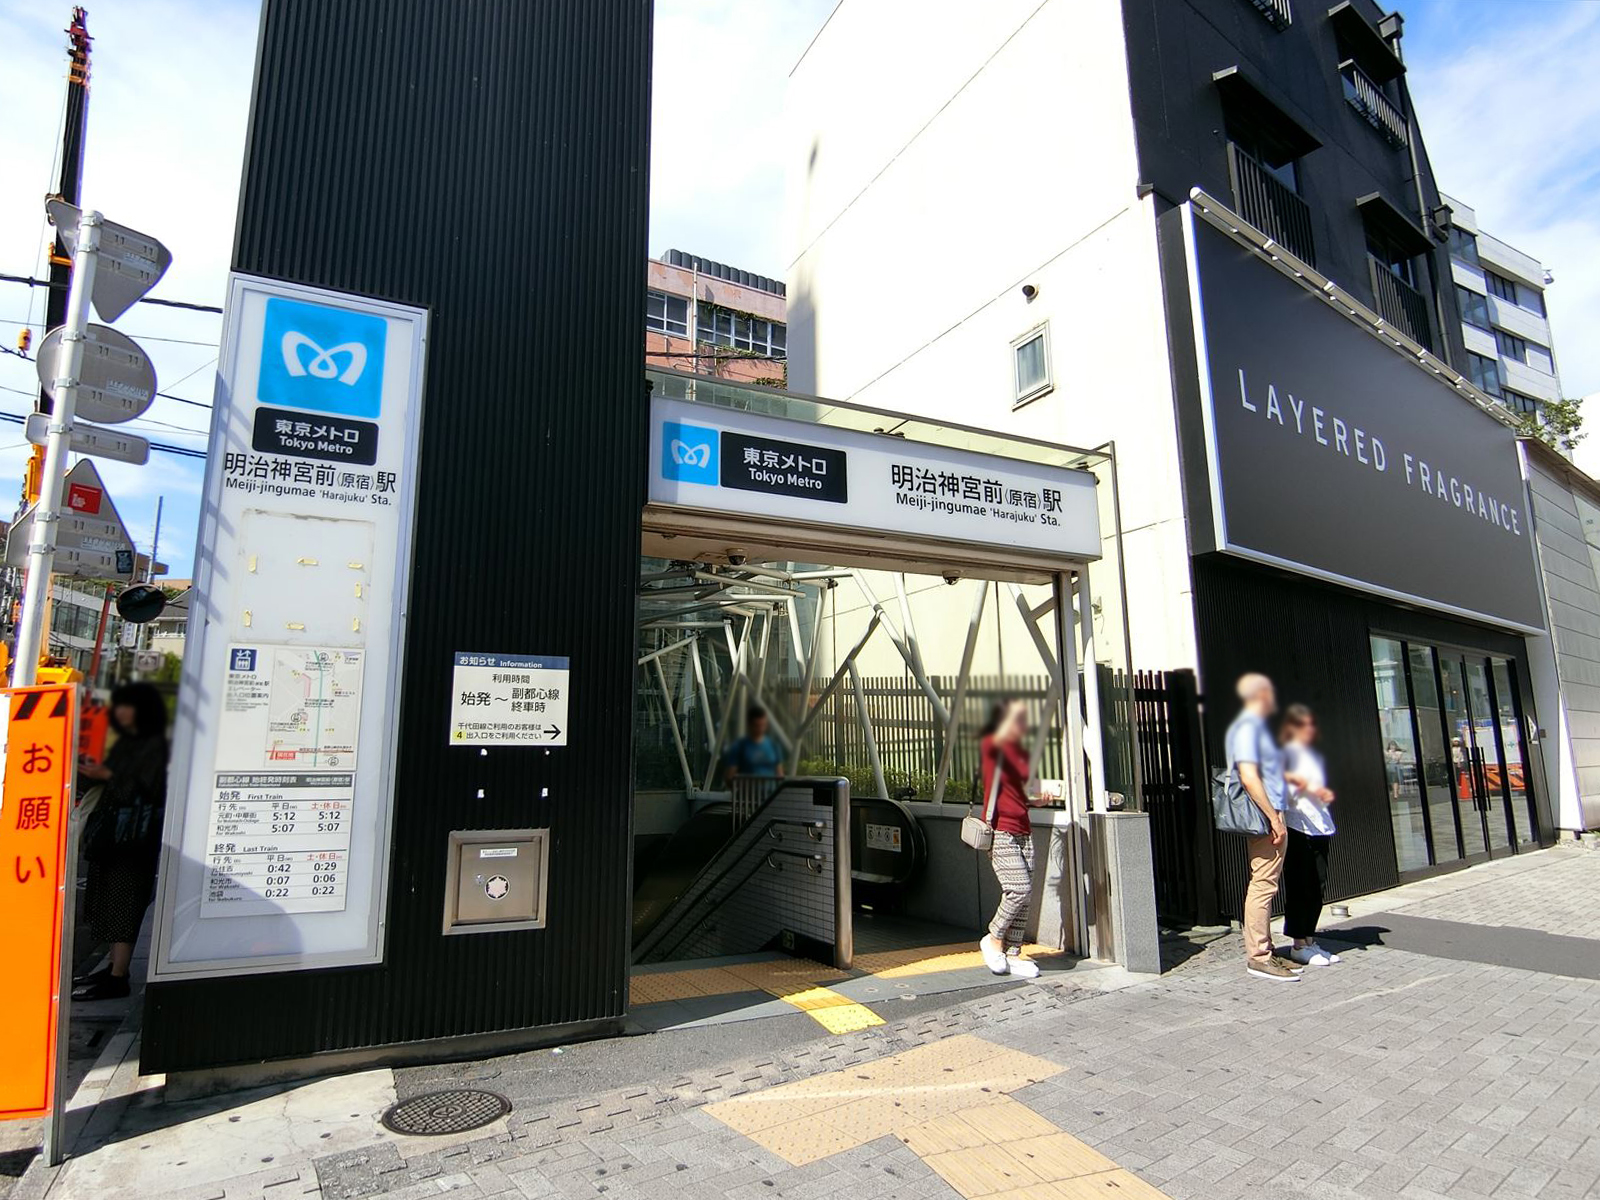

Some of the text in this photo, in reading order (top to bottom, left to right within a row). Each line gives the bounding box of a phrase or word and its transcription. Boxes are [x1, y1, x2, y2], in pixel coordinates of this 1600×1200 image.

[275, 420, 359, 443] 東京メトロ
[280, 436, 353, 454] Tokyo Metro
[1239, 369, 1521, 535] LAYERED FRAGRANCE
[744, 447, 826, 475] 東京メトロ
[749, 468, 822, 489] Tokyo Metro
[226, 477, 316, 498] Meiji-jingumae
[371, 494, 391, 506] Sta.
[897, 493, 986, 516] Meiji-jingumae
[1041, 514, 1060, 526] Sta.
[460, 657, 496, 666] お知らせ
[493, 674, 530, 683] 利用時間
[512, 688, 559, 700] 副都心線
[511, 702, 546, 712] 終車時
[220, 791, 240, 800] 始発
[15, 742, 54, 883] お願い
[273, 812, 295, 821] 5:12
[319, 811, 341, 820] 5:12
[272, 824, 294, 833] 5:07
[318, 823, 339, 831] 5:07
[215, 844, 235, 853] 終発
[268, 864, 291, 873] 0:42
[314, 862, 336, 871] 0:29
[267, 876, 290, 885] 0:07
[313, 874, 335, 883] 0:06
[265, 889, 289, 898] 0:22
[312, 887, 334, 895] 0:22
